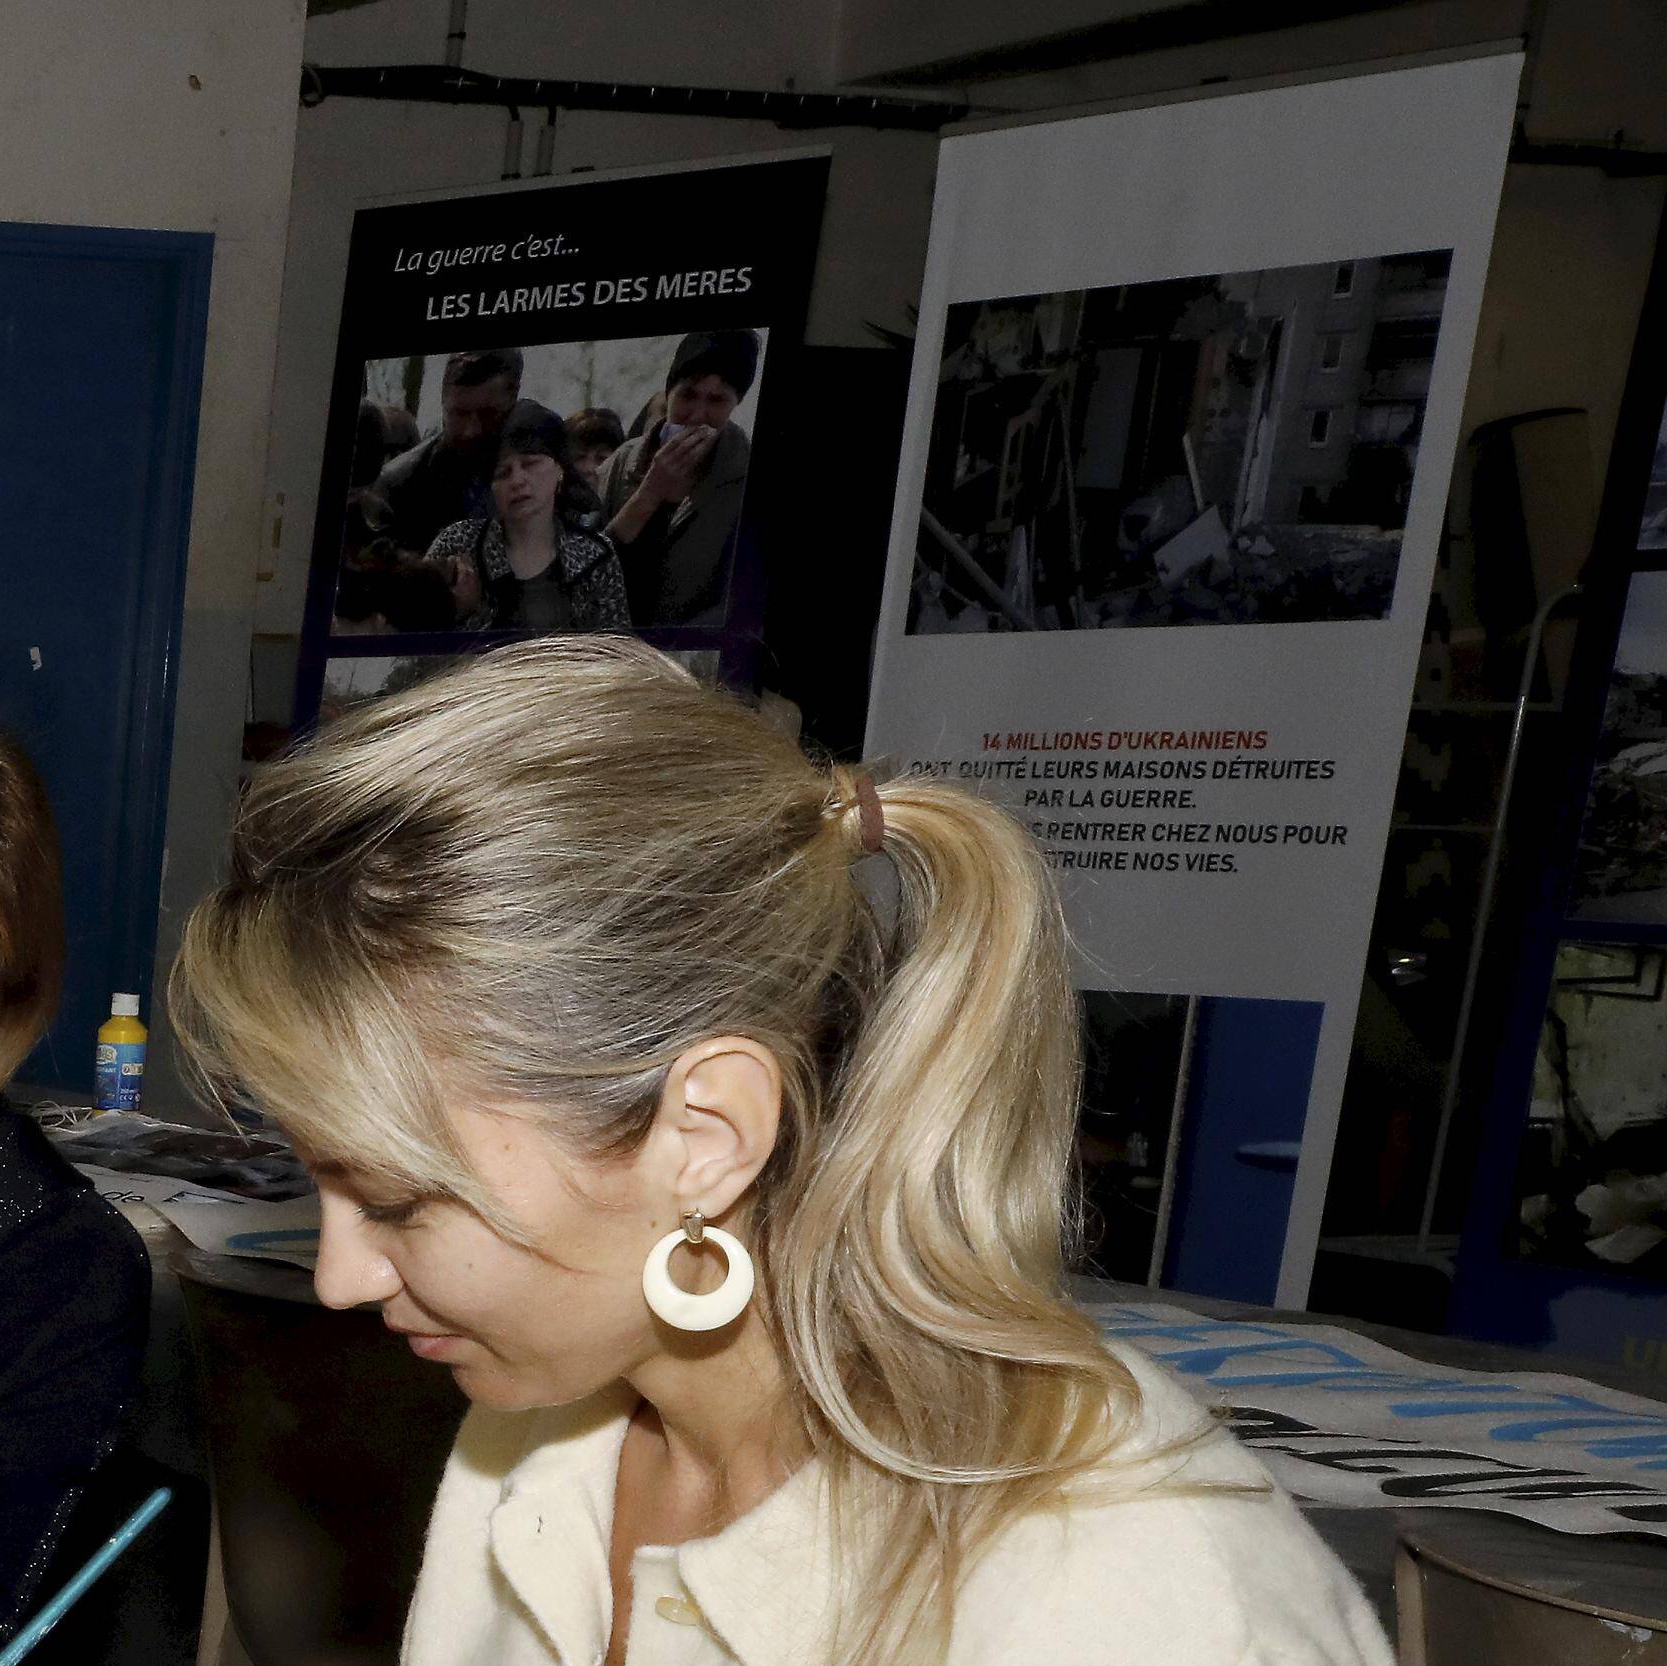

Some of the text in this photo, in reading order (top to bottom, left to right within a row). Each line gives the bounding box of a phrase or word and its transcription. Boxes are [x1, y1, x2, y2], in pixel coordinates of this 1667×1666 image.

[393, 234, 579, 275] La guerre c'est...
[426, 266, 753, 321] LES LARMES DES MERES
[981, 730, 1269, 752] 14 MILLIONS D'UKRAINIENS
[1031, 760, 1099, 780] LEURS
[1103, 760, 1208, 781] MAISONS
[1211, 755, 1336, 781] DÉTRUITES
[1024, 790, 1197, 809] PAR LA GUERRE.
[1047, 822, 1146, 842] RENTRER
[1152, 824, 1211, 843] CHEZ
[1215, 825, 1278, 844] NOUS
[1283, 826, 1348, 845] POUR
[1133, 853, 1180, 871] NOS
[1184, 854, 1238, 873] VIES.
